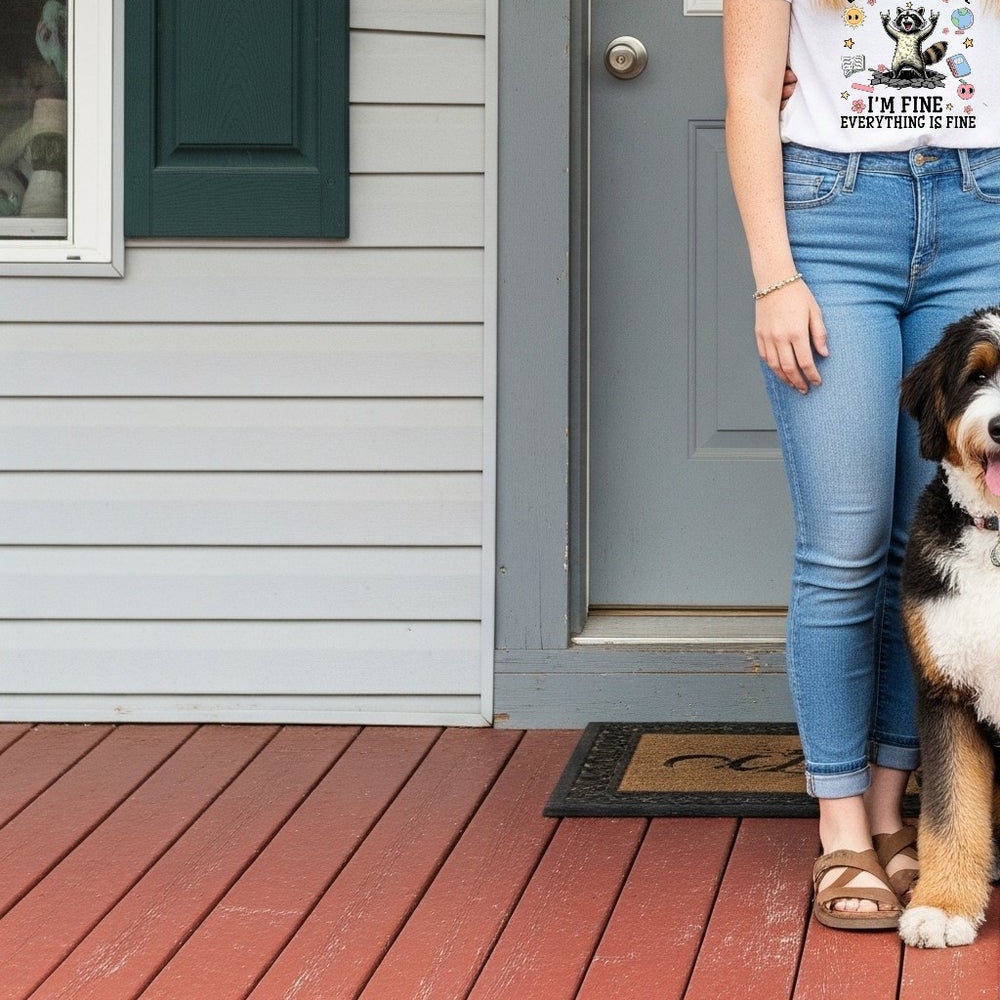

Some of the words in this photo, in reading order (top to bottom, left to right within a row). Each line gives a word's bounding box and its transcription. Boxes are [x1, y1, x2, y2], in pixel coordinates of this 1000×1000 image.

[867, 95, 896, 113] I'M
[901, 95, 943, 113] FINE
[840, 115, 926, 129] EVERYTHING
[929, 115, 942, 129] IS
[946, 115, 977, 129] FINE
